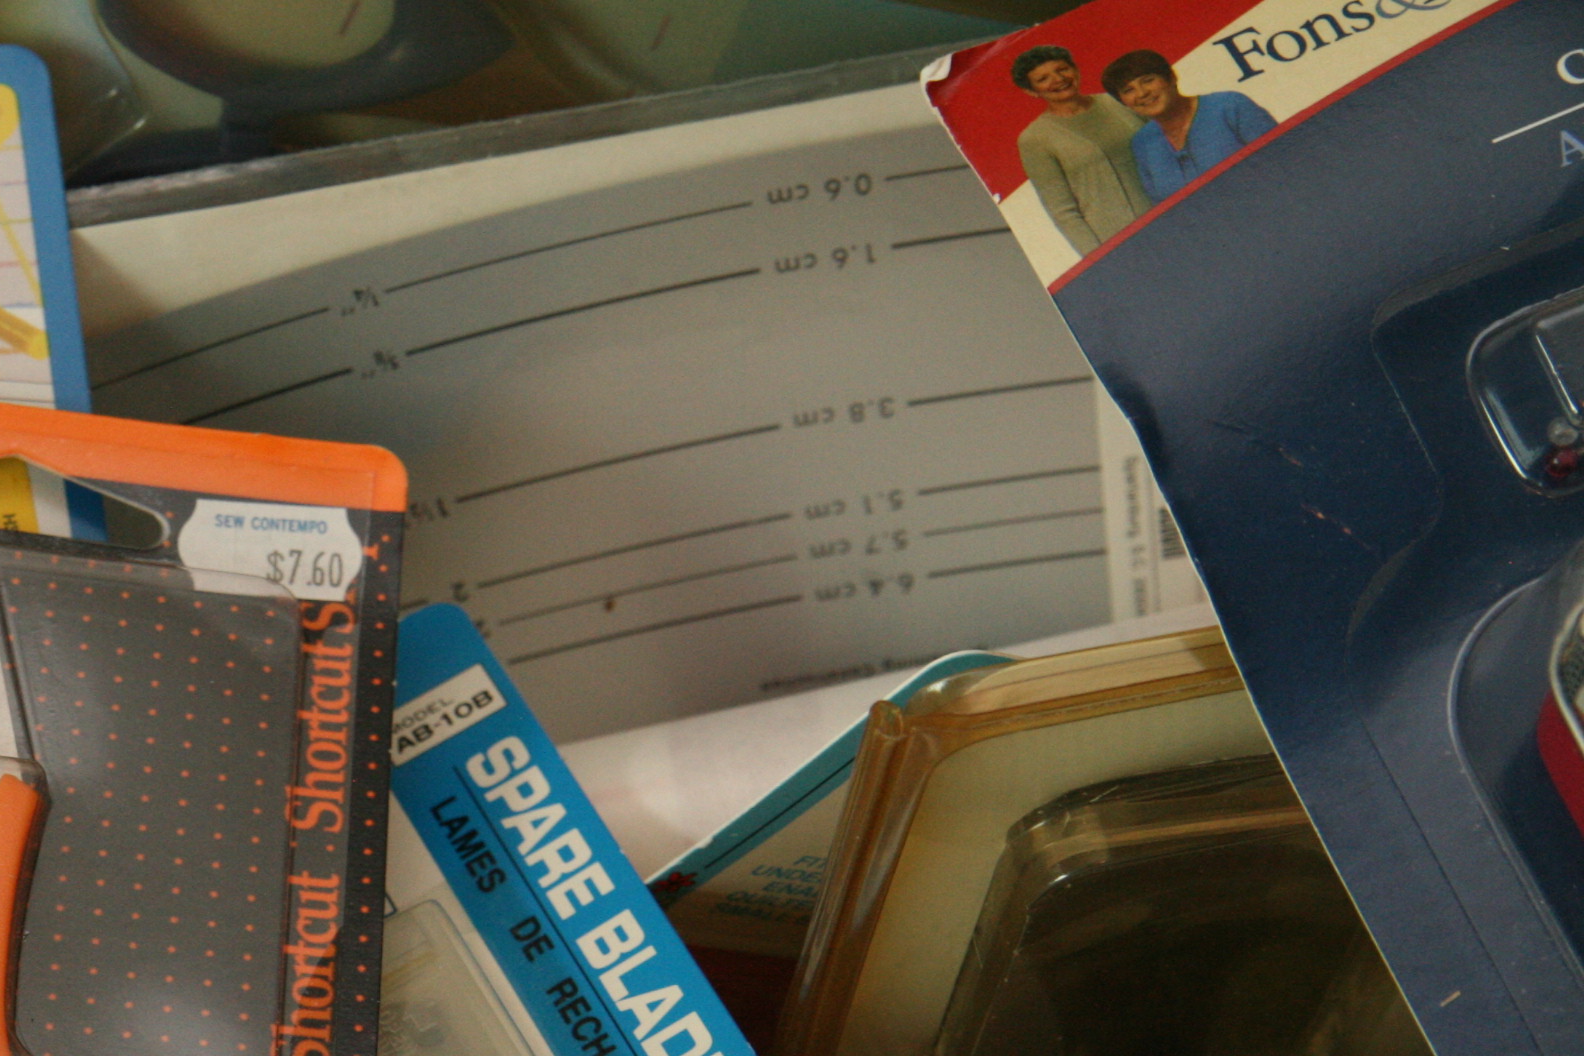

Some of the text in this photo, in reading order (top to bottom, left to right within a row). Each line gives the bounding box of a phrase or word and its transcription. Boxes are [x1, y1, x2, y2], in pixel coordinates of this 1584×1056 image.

[768, 173, 873, 206] 0.6 cm
[774, 244, 876, 275] 1.6 cm
[793, 397, 896, 428] 3.8 cm
[215, 513, 327, 534] SEW CONTEMPO
[804, 498, 846, 521] cm
[809, 538, 851, 561] cm
[266, 549, 344, 588] $7.60
[816, 579, 857, 602] cm
[283, 640, 355, 834] Shortcut
[394, 690, 494, 755] AB-10B
[466, 734, 616, 921] SPARE
[430, 796, 506, 894] LAMES
[510, 914, 555, 963] DE
